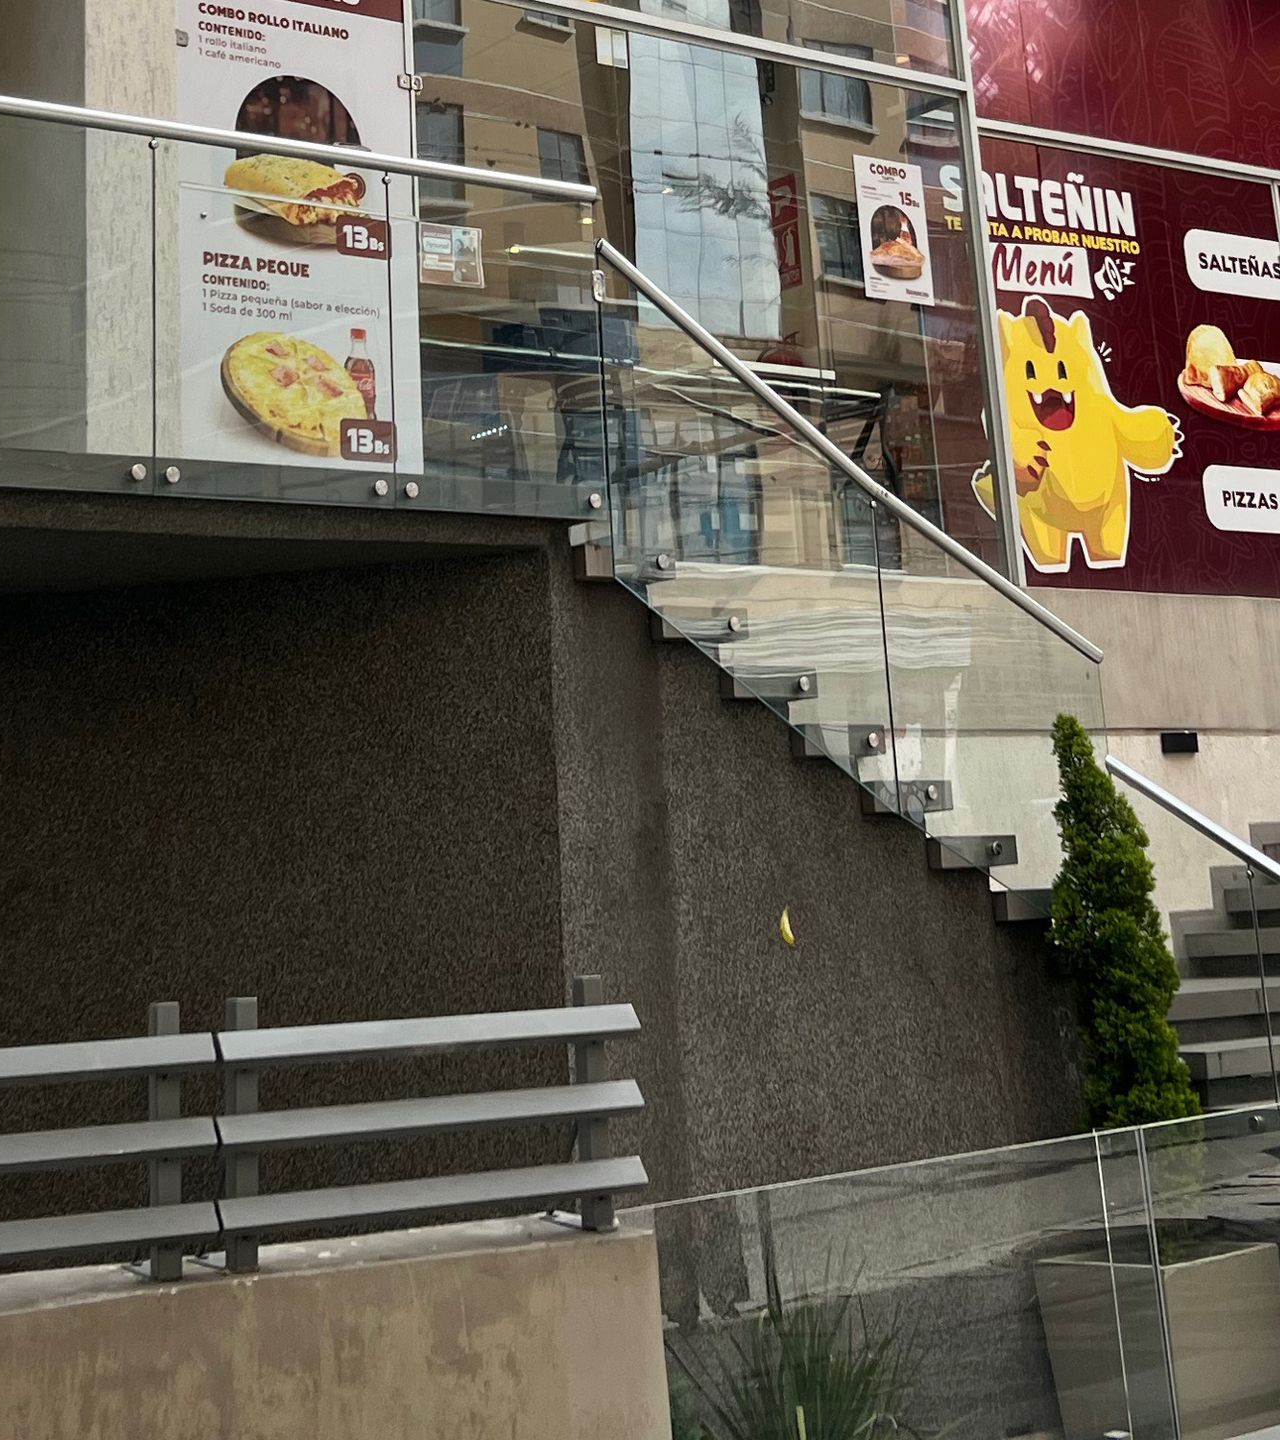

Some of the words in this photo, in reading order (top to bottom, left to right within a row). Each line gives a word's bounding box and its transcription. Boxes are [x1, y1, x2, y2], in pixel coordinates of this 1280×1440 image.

[198, 2, 245, 21] COMBO
[248, 12, 290, 29] ROLLO
[292, 19, 350, 40] ITALIANO
[198, 21, 266, 42] CONTENIDO:
[205, 35, 227, 48] rollo
[230, 40, 267, 54] italiano
[205, 48, 226, 59] café
[229, 53, 281, 69] americano
[869, 162, 906, 180] COMBO
[944, 215, 963, 232] TE
[1011, 227, 1024, 239] A
[1024, 227, 1081, 247] PROBAR
[1081, 234, 1141, 255] NUESTRO
[203, 251, 252, 272] PIZZA
[256, 258, 310, 278] PEQUE
[991, 241, 1074, 287] Menú
[202, 273, 270, 291] CONTENIDO:
[210, 289, 238, 302] Pizza
[241, 294, 288, 308] pequeña
[290, 297, 323, 311] (sabor
[335, 304, 380, 319] elección)
[210, 302, 237, 315] Soda
[240, 305, 253, 317] de
[257, 308, 276, 320] 300
[278, 310, 293, 321] ml
[1222, 490, 1279, 511] PIZZAS
